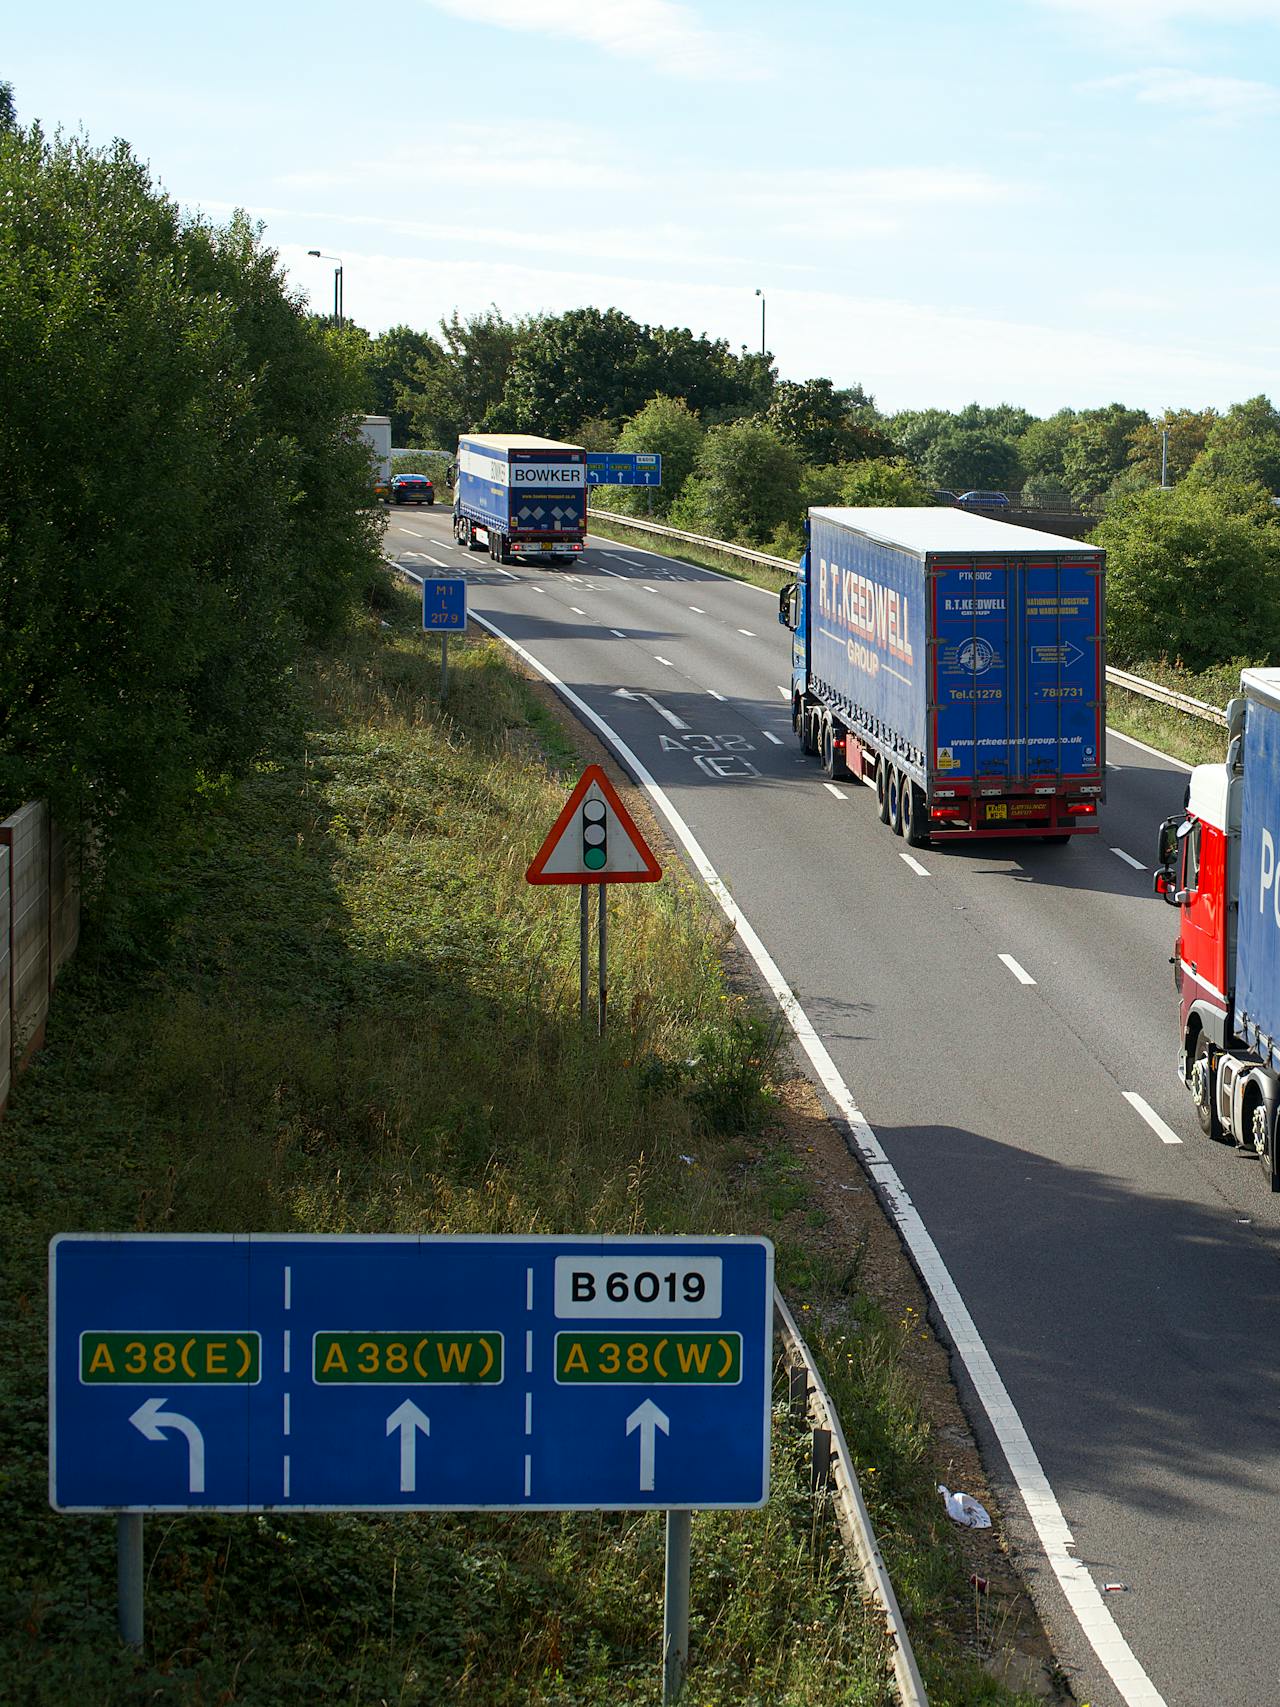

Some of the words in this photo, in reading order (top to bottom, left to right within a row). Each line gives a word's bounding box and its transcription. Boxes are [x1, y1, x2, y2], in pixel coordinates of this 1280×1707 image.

[515, 469, 580, 482] BOWKER
[958, 571, 973, 581] PTK
[975, 571, 992, 580] 6012
[436, 585, 453, 595] M1
[441, 599, 447, 609] L
[847, 638, 879, 674] GROUP
[658, 734, 757, 752] A38
[571, 1271, 706, 1303] B6019
[88, 1337, 252, 1379] A38(E)
[321, 1337, 495, 1379] A38(W)
[562, 1338, 733, 1379] A38(W)
